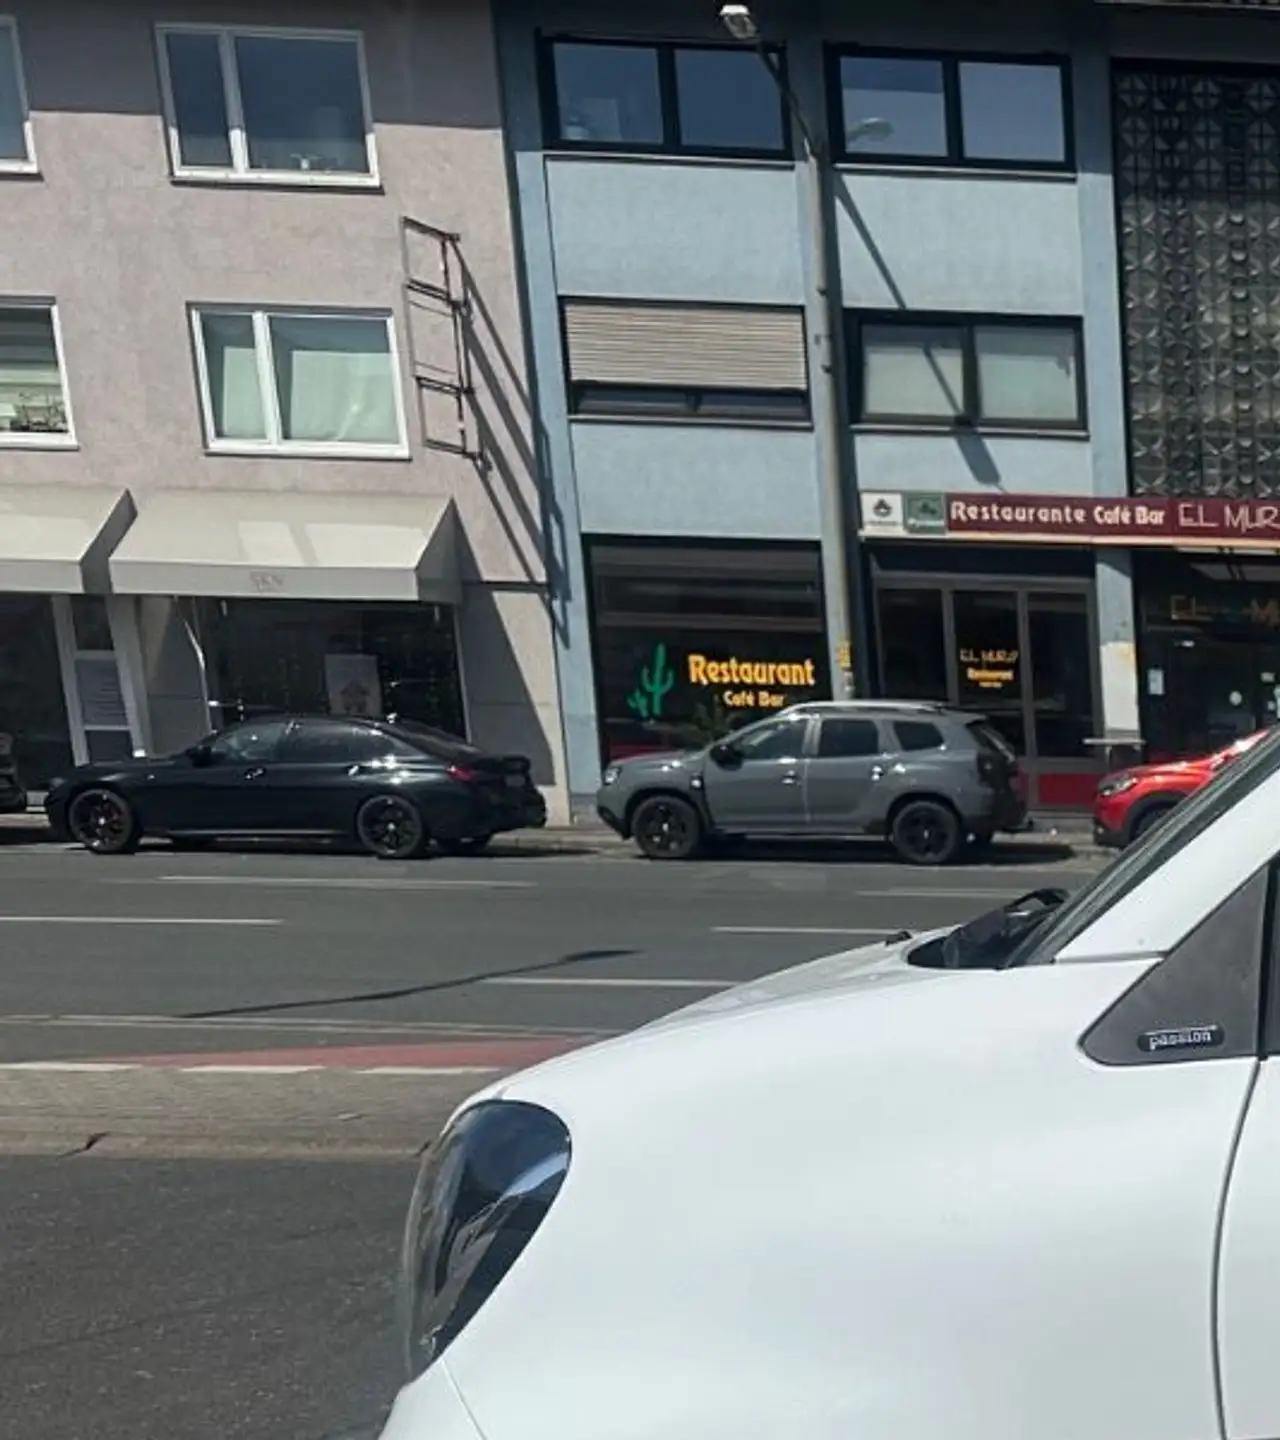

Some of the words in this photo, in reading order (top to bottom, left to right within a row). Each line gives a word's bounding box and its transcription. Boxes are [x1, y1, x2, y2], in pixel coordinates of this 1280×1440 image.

[950, 501, 1087, 524] Restaurante
[1093, 504, 1131, 525] Café
[1135, 506, 1165, 525] Bar
[1178, 504, 1218, 528] EL
[687, 653, 816, 686] Restaurant
[722, 690, 754, 707] Café
[758, 690, 785, 707] Bar
[1149, 1030, 1212, 1050] passion
